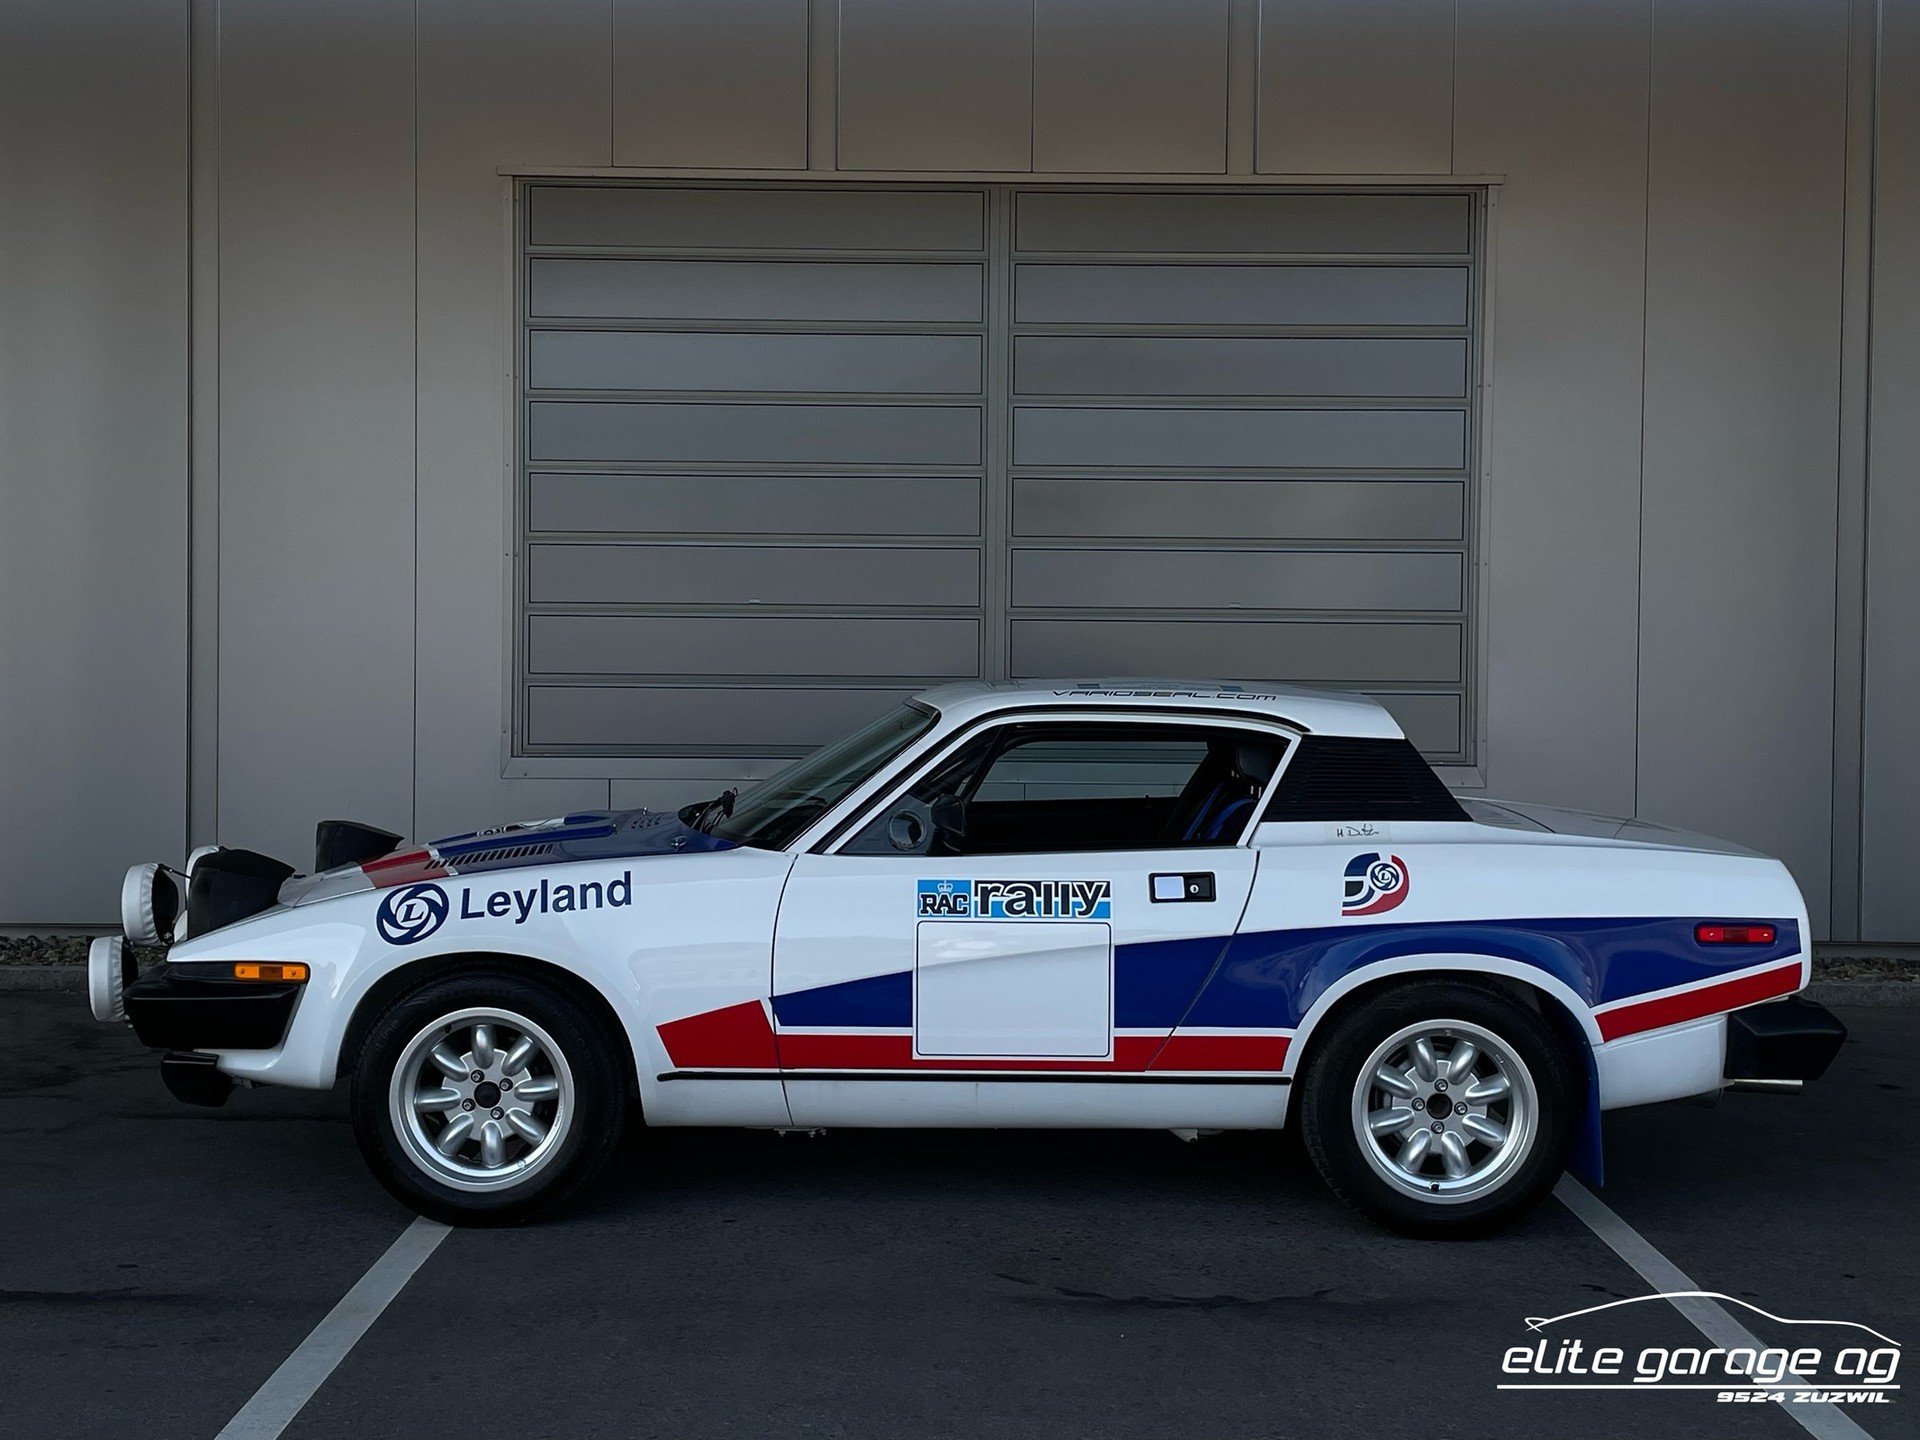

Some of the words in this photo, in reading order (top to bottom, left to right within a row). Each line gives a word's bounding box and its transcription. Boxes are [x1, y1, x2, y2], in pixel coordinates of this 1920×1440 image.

[460, 871, 632, 924] Leyland
[920, 893, 968, 916] RAC
[977, 880, 1107, 917] rally
